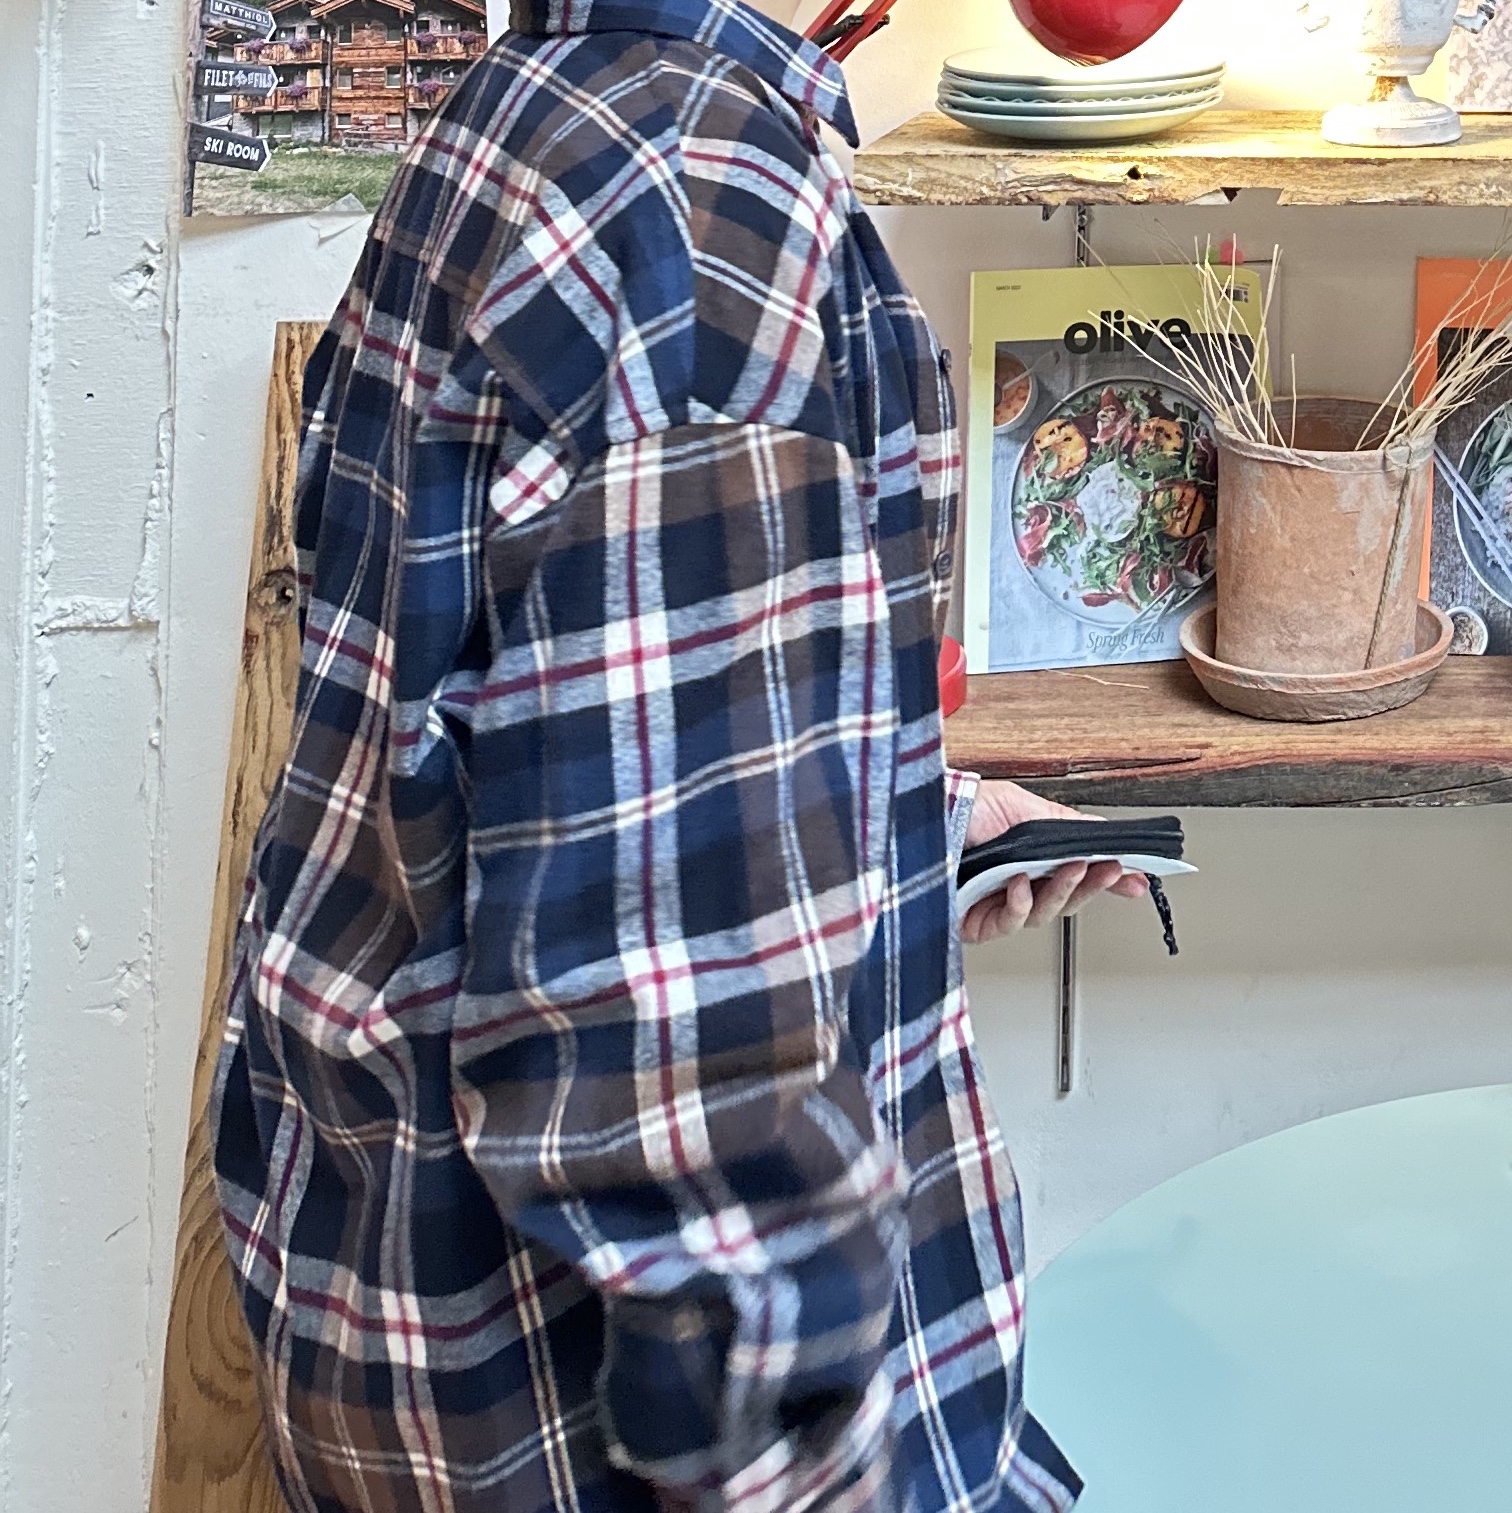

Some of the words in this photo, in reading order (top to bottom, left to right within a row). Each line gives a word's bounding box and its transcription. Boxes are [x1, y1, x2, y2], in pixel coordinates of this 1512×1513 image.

[214, 1, 268, 24] MATTHIOL
[203, 68, 235, 87] FILET
[253, 72, 273, 88] FILS
[203, 136, 224, 154] SKI
[226, 141, 260, 161] ROOM
[1063, 309, 1192, 355] olive
[1086, 631, 1128, 653] Spring
[1131, 627, 1164, 647] Fresh
